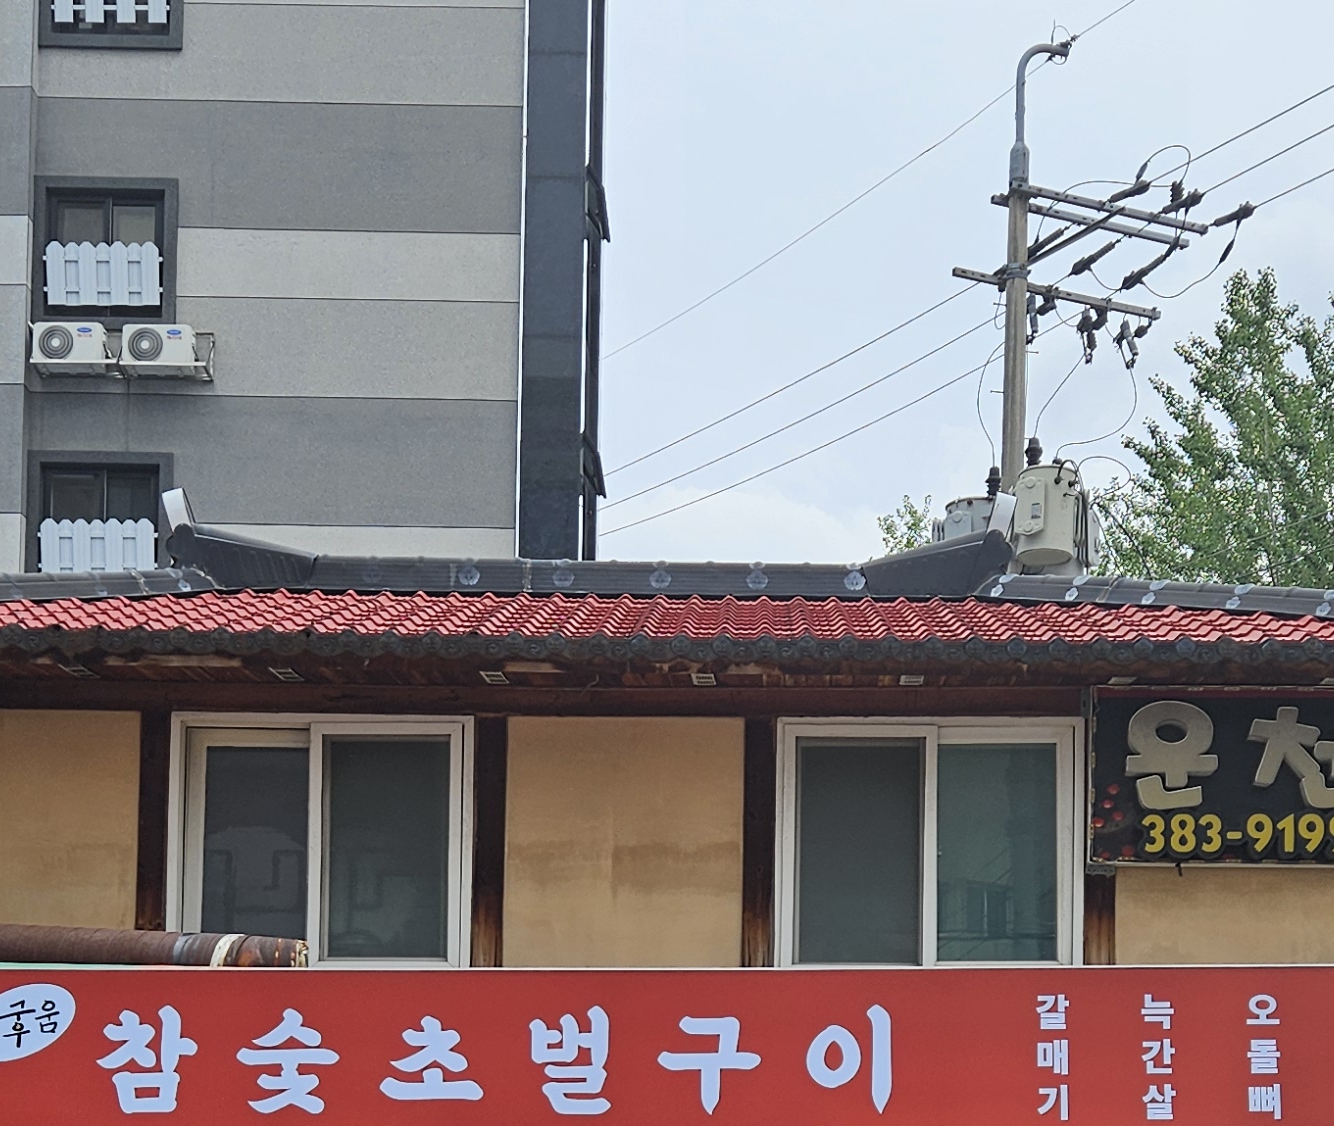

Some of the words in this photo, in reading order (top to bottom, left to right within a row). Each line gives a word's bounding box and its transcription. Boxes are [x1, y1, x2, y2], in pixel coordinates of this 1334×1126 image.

[1035, 993, 1069, 1121] 갈매기
[1140, 993, 1177, 1121] 늑간살
[1245, 993, 1282, 1120] 오돌뼈
